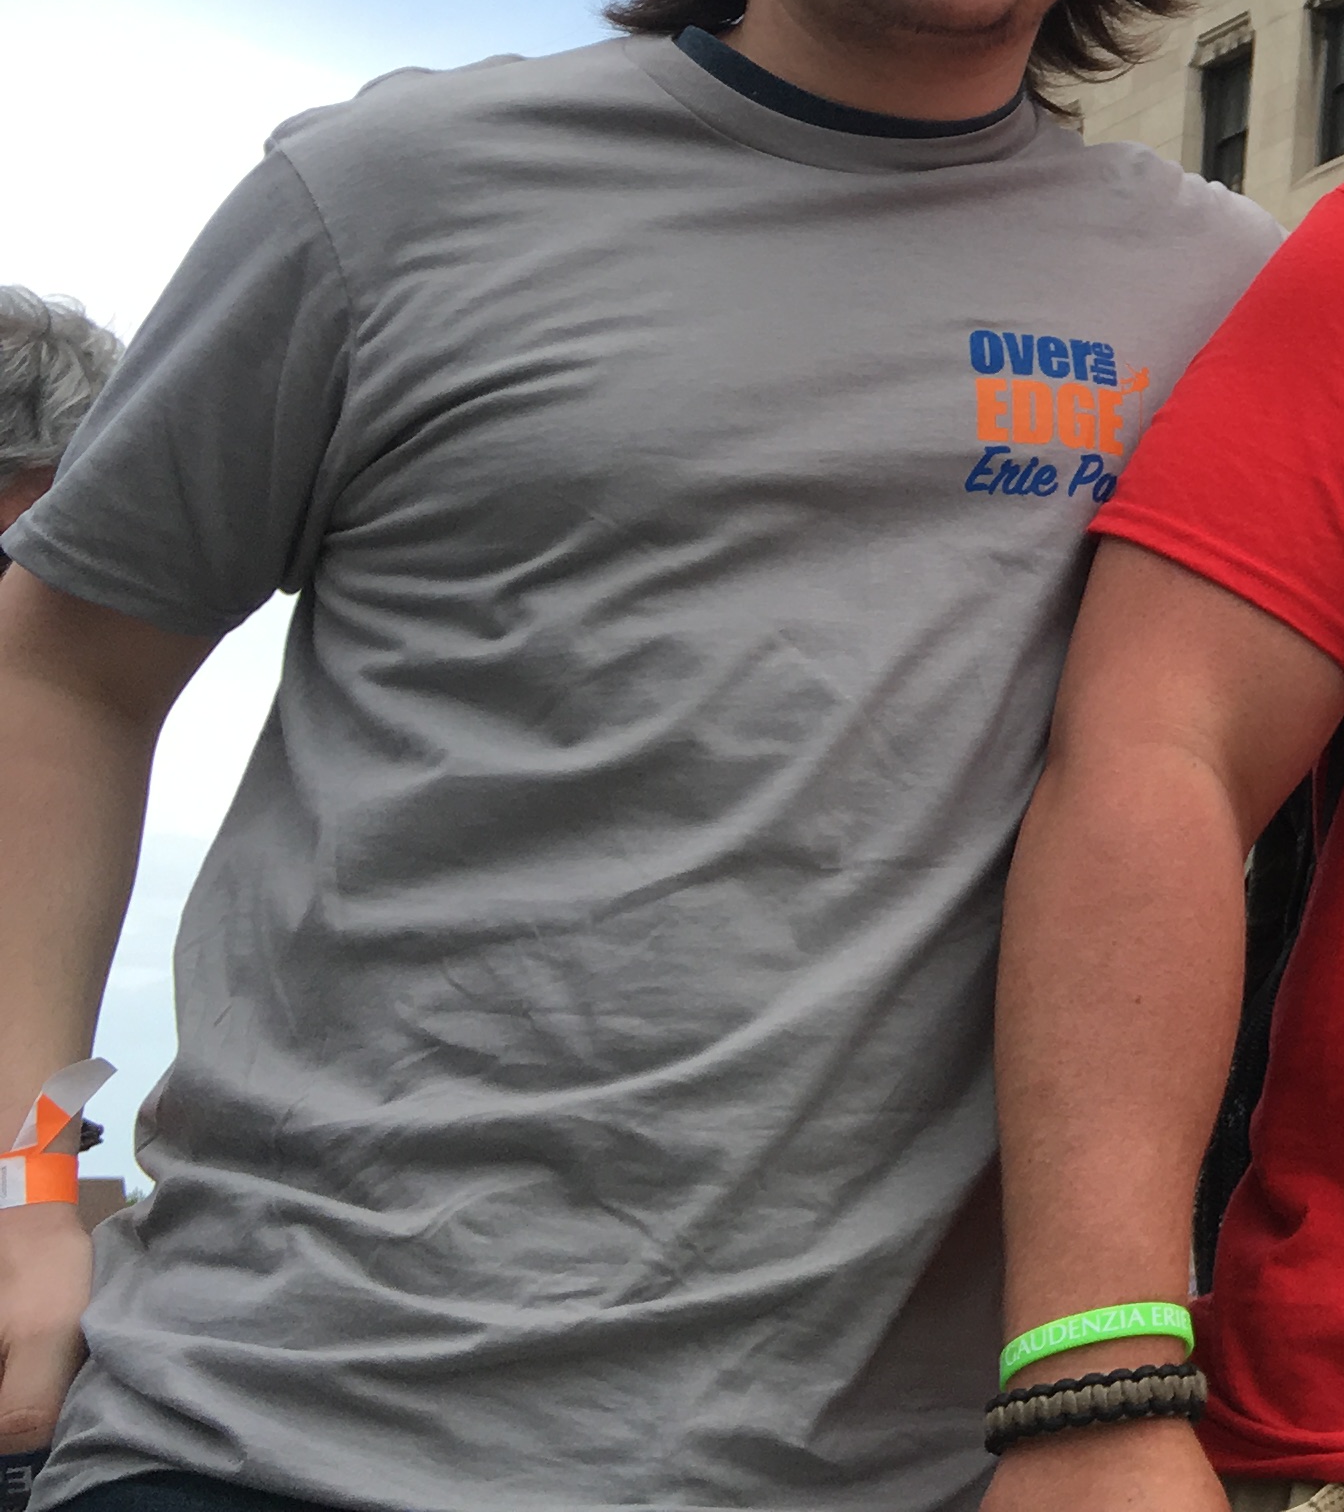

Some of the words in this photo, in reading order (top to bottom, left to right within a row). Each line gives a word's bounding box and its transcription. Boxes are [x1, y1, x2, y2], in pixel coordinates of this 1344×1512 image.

[1090, 341, 1117, 386] the
[975, 377, 1125, 457] EDGE
[964, 445, 1059, 497] Erie
[1004, 1306, 1146, 1367] GAUDENZIA
[1150, 1305, 1191, 1332] ERIE
